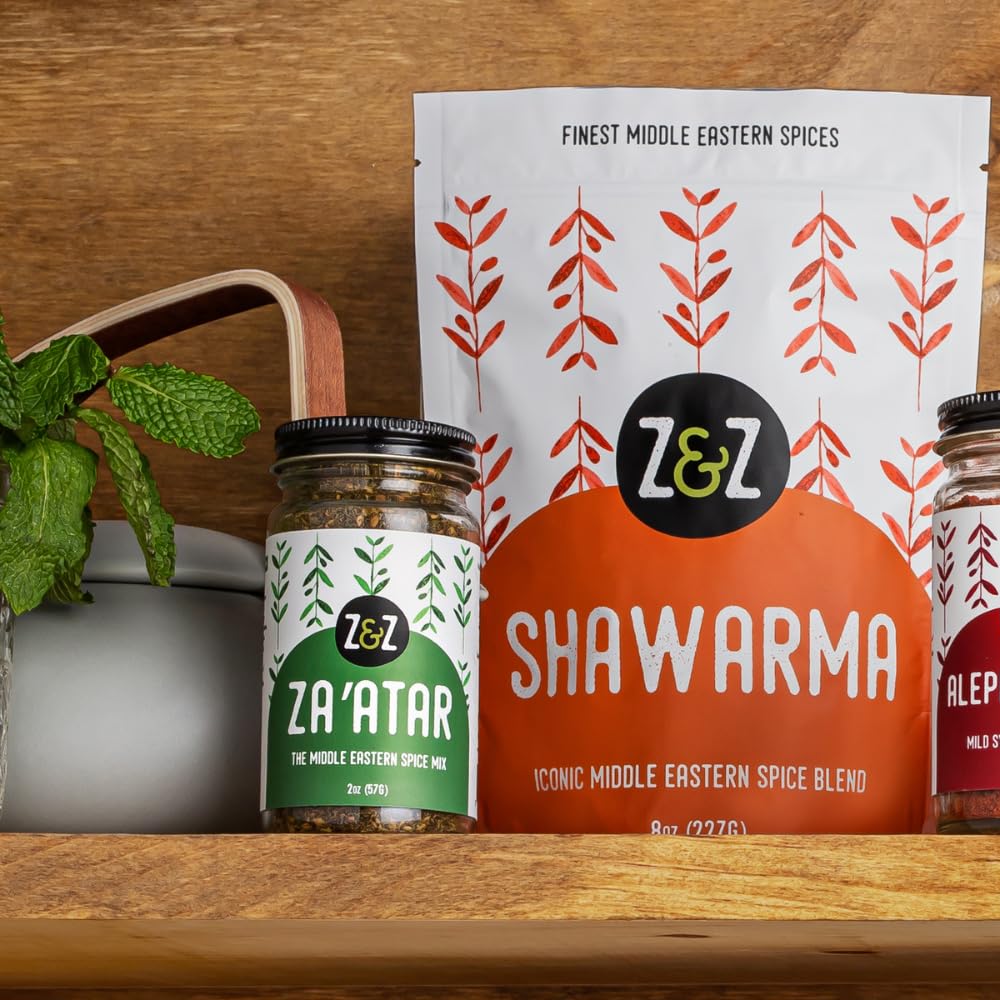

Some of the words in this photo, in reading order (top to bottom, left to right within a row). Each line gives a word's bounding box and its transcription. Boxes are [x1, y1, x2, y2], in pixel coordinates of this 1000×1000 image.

[563, 124, 619, 145] FINEST
[627, 125, 690, 145] MIDDLE
[698, 125, 772, 146] EASTERN
[781, 125, 838, 147] SPICES
[639, 417, 761, 499] Z&Z
[344, 613, 398, 652] Z&Z
[507, 605, 897, 701] SHAWARMA
[288, 680, 452, 740] ZA'ATAR
[966, 734, 988, 748] MILD
[291, 750, 306, 766] THE
[309, 750, 347, 766] MIDDLE
[350, 751, 397, 767] EASTERN
[400, 752, 429, 769] SPICE
[431, 754, 447, 770] MIX
[346, 783, 361, 794] 2oz
[364, 783, 389, 797] (57G)
[535, 767, 583, 790] ICONIC
[591, 764, 656, 788] MIDDLE
[665, 764, 749, 788] EASTERN
[758, 765, 807, 790] SPICE
[815, 767, 866, 793] BLEND
